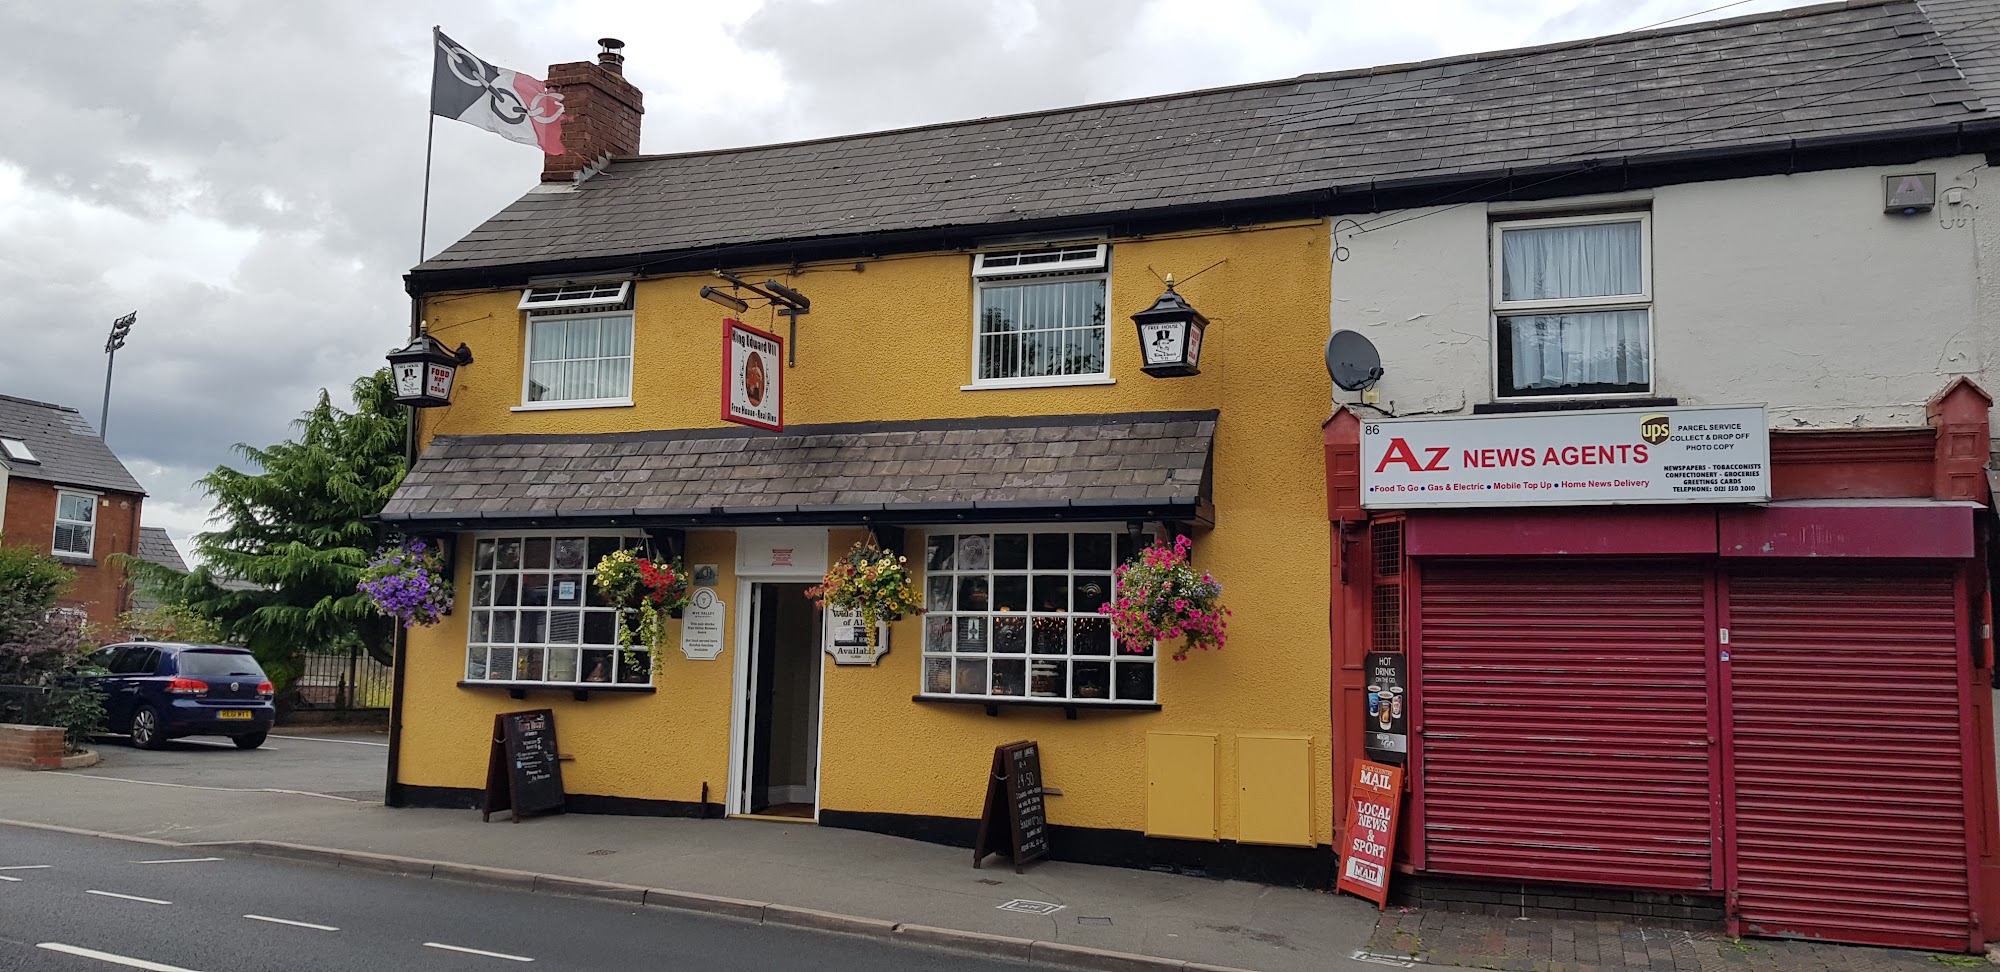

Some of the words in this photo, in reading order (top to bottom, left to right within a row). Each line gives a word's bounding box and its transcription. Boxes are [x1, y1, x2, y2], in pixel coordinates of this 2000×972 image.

[732, 329, 746, 348] King
[746, 334, 767, 354] Edward
[768, 341, 777, 357] VII
[431, 368, 450, 378] FOOD
[731, 402, 741, 414] Free
[742, 405, 755, 417] House
[757, 409, 767, 421] Real
[767, 412, 777, 423] Ales
[1365, 425, 1380, 435] 86
[1642, 424, 1669, 442] ups
[1713, 443, 1735, 451] COPY
[1463, 447, 1536, 468] NEWS
[1542, 444, 1649, 466] AGENTS
[1397, 484, 1406, 492] To
[1408, 484, 1419, 492] Go
[1446, 483, 1451, 491] &
[1453, 483, 1485, 491] Electric
[1494, 482, 1521, 490] Mobile
[1523, 481, 1539, 490] Top
[1540, 481, 1552, 490] Up
[1561, 480, 1586, 488] Home
[1588, 480, 1612, 488] News
[1614, 479, 1650, 488] Delivery
[1379, 657, 1392, 666] HOT
[1375, 668, 1396, 677] DRINKS
[1362, 764, 1374, 772] BLACK
[1375, 767, 1393, 776] COUNTRY
[1360, 770, 1391, 790] MAIL
[1358, 801, 1390, 820] LOCAL
[1358, 813, 1388, 833] NEWS
[1367, 829, 1375, 842] &
[1353, 838, 1386, 858] SPORT
[1355, 865, 1377, 882] MAIL
